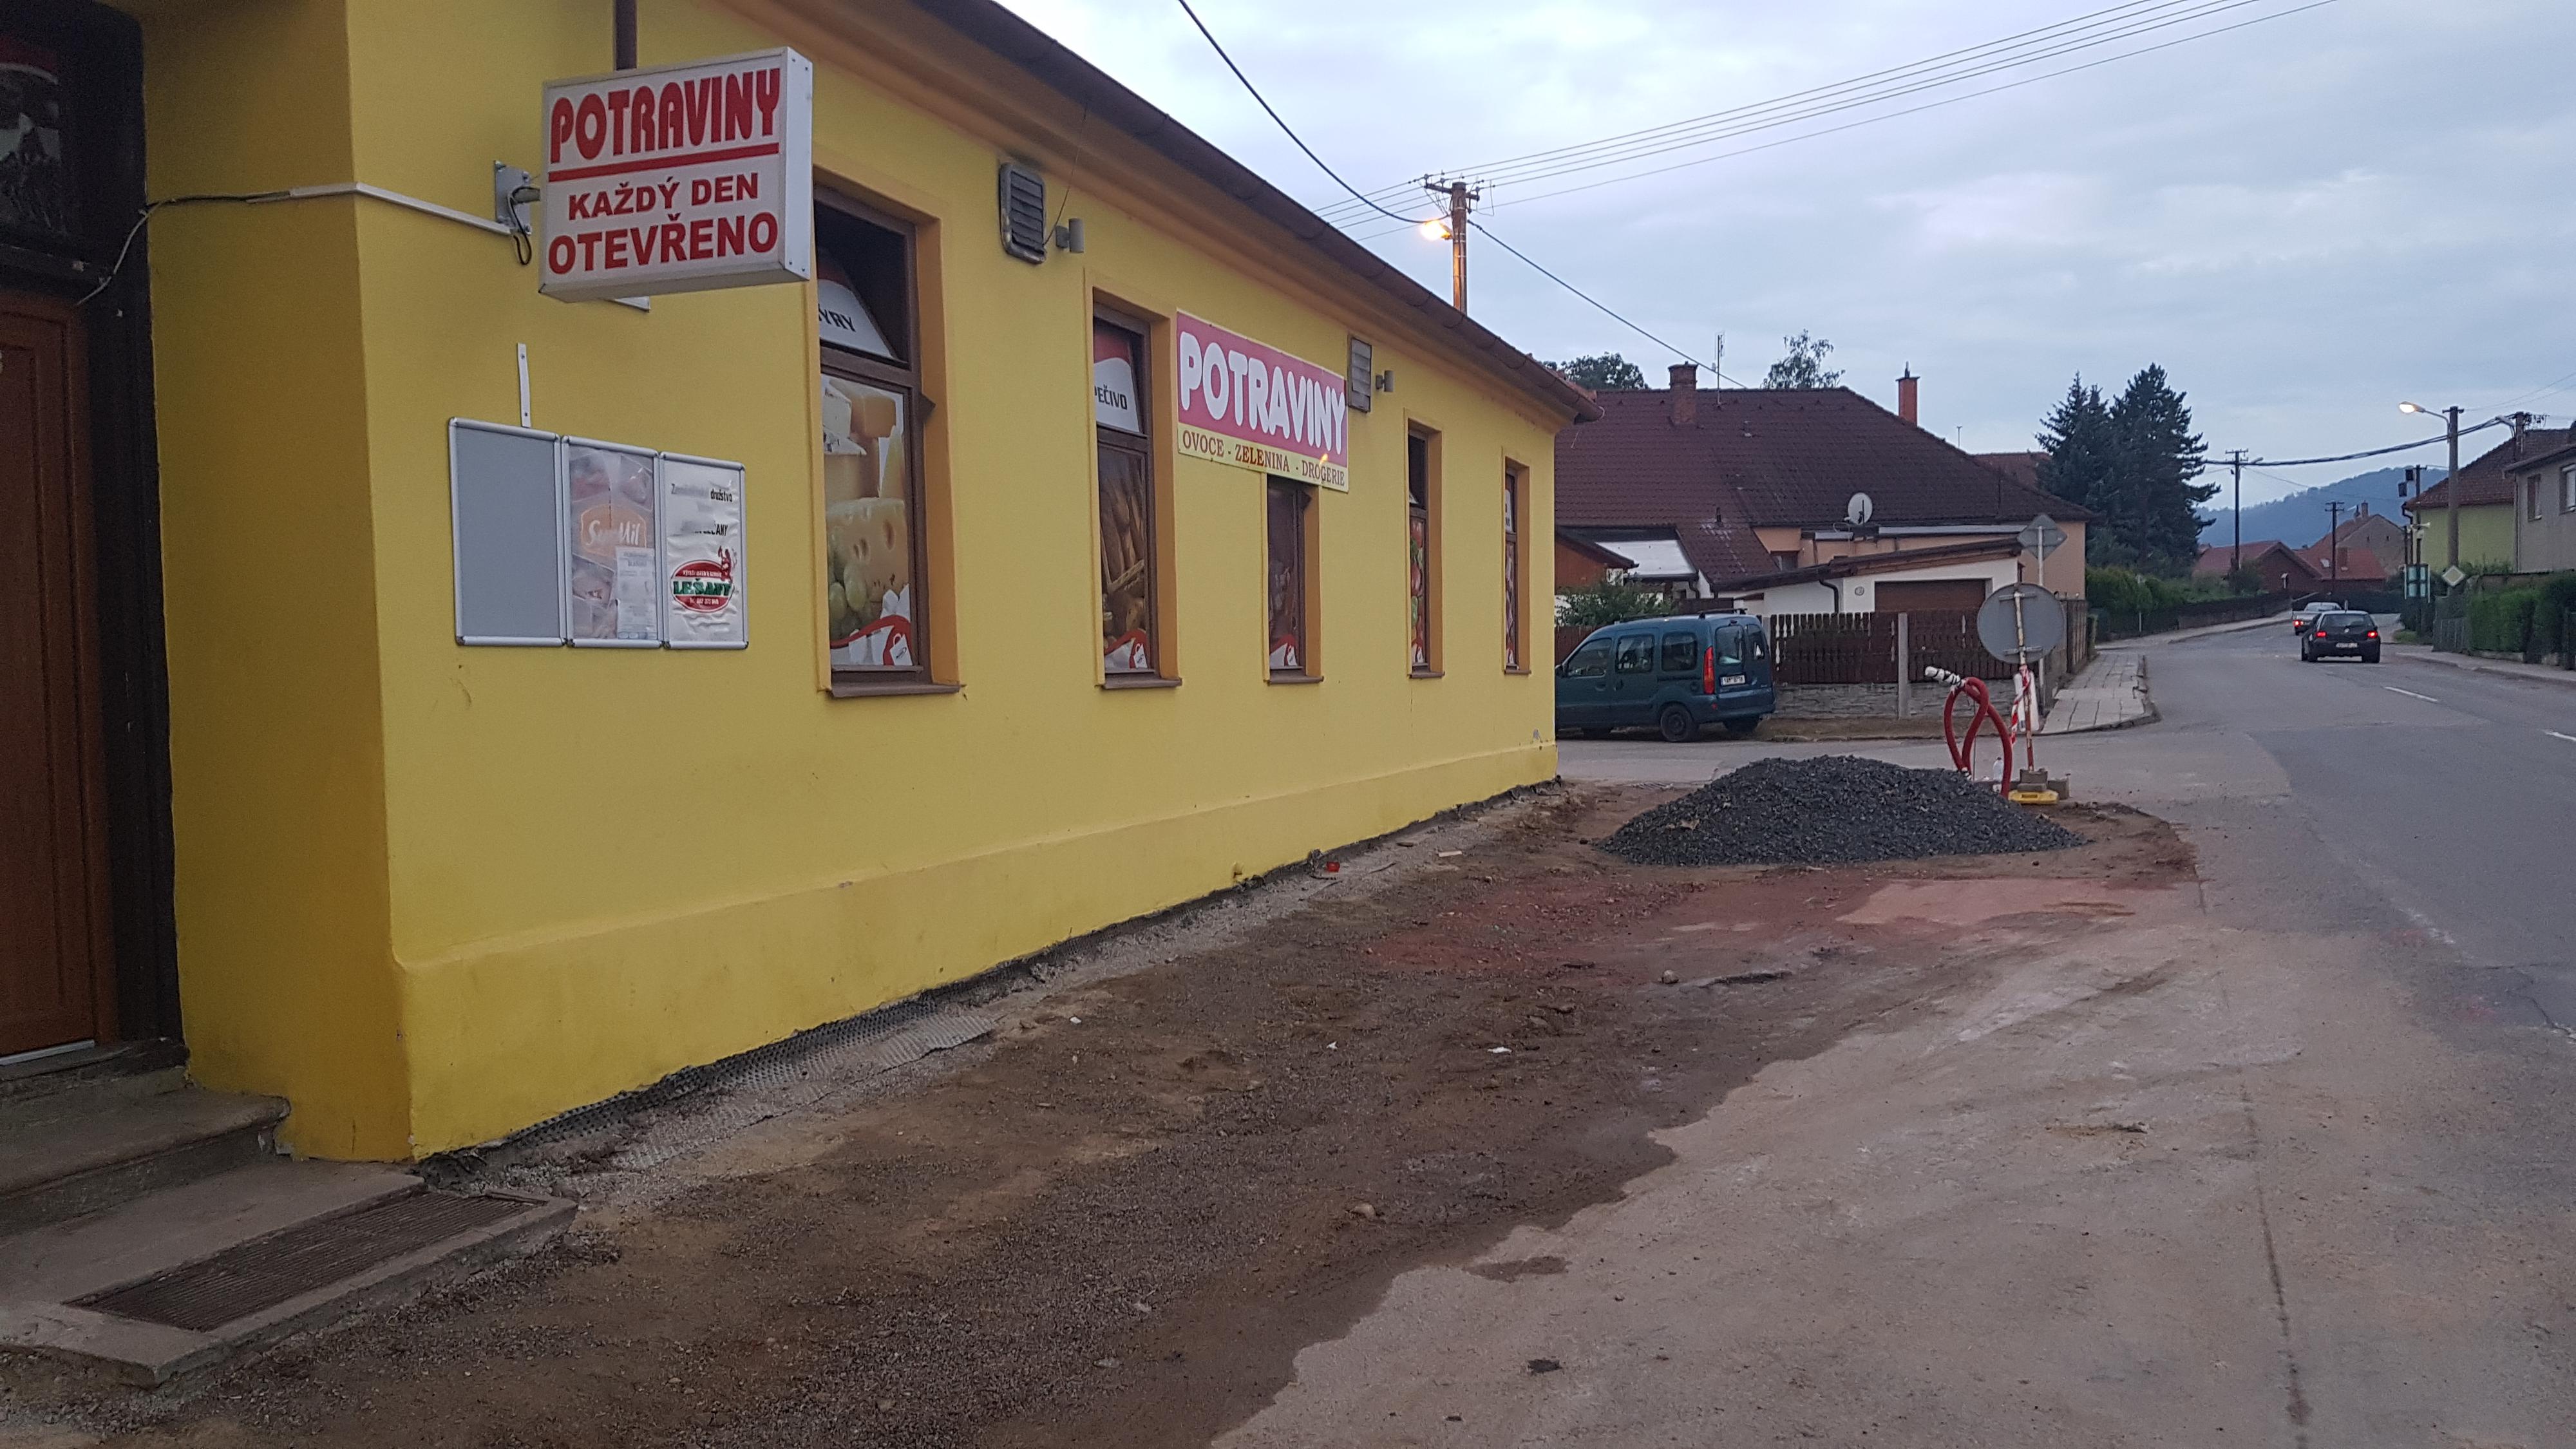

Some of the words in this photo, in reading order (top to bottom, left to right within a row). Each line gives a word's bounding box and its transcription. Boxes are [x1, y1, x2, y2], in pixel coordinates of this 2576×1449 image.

[550, 68, 781, 164] POTRAVINY
[569, 176, 680, 220] KAŽDÝ
[691, 173, 759, 206] DEN
[548, 212, 778, 275] OTEVŘENO
[1180, 330, 1346, 455] POTRAVINY
[1182, 430, 1224, 457] OVOCE
[1235, 444, 1291, 473] ZELENINA
[1302, 459, 1345, 486] DROGERIE
[710, 488, 733, 502] družstvo
